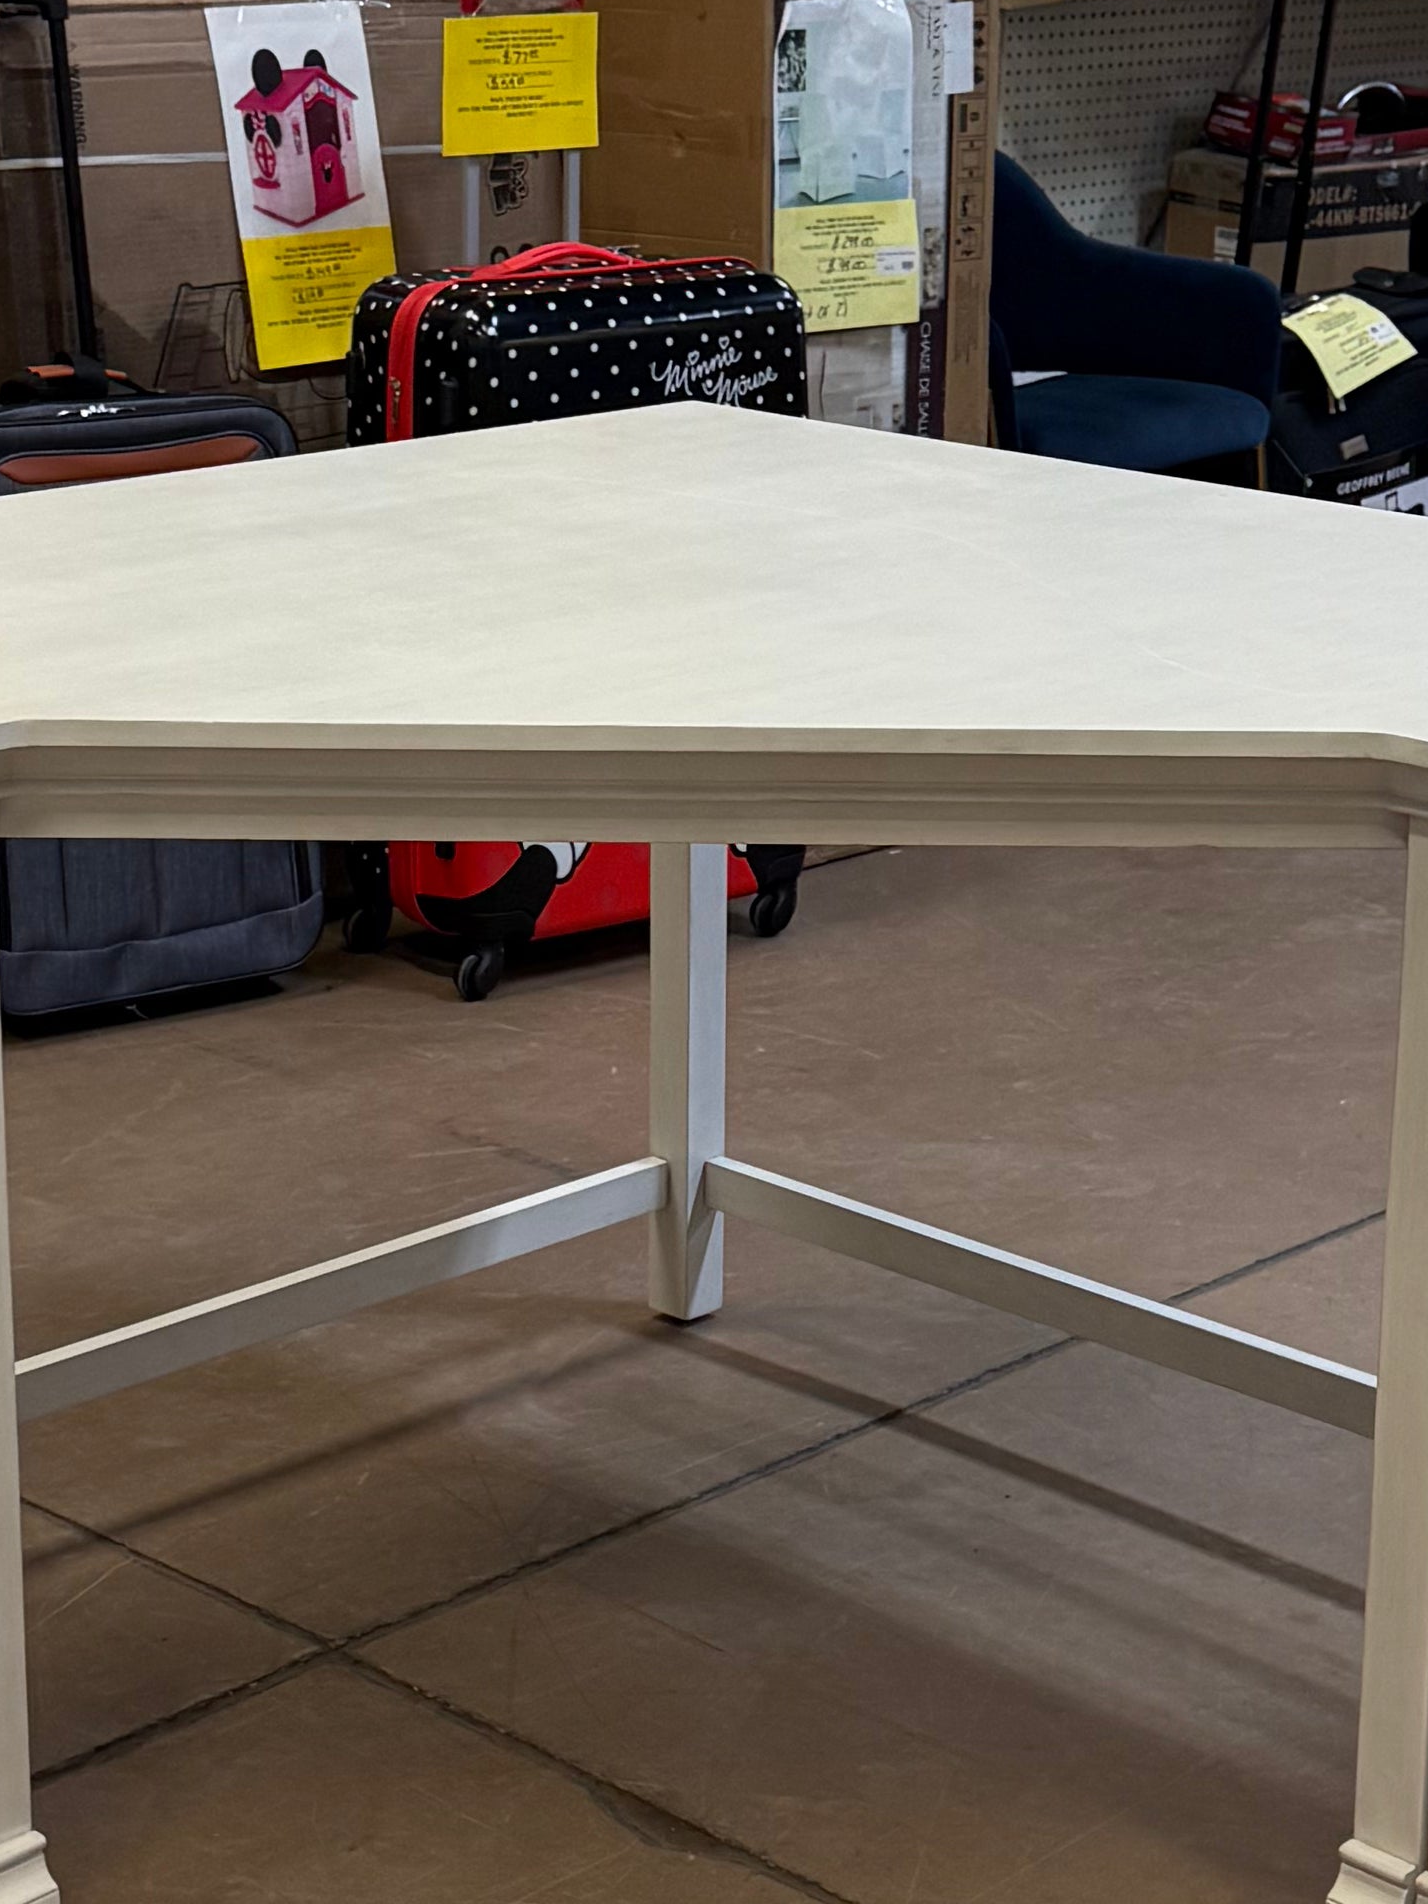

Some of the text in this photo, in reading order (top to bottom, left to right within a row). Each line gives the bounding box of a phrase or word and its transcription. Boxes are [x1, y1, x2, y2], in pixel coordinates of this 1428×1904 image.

[649, 336, 743, 396] Minnie
[701, 366, 779, 407] Mouse
[917, 400, 930, 433] SALL
